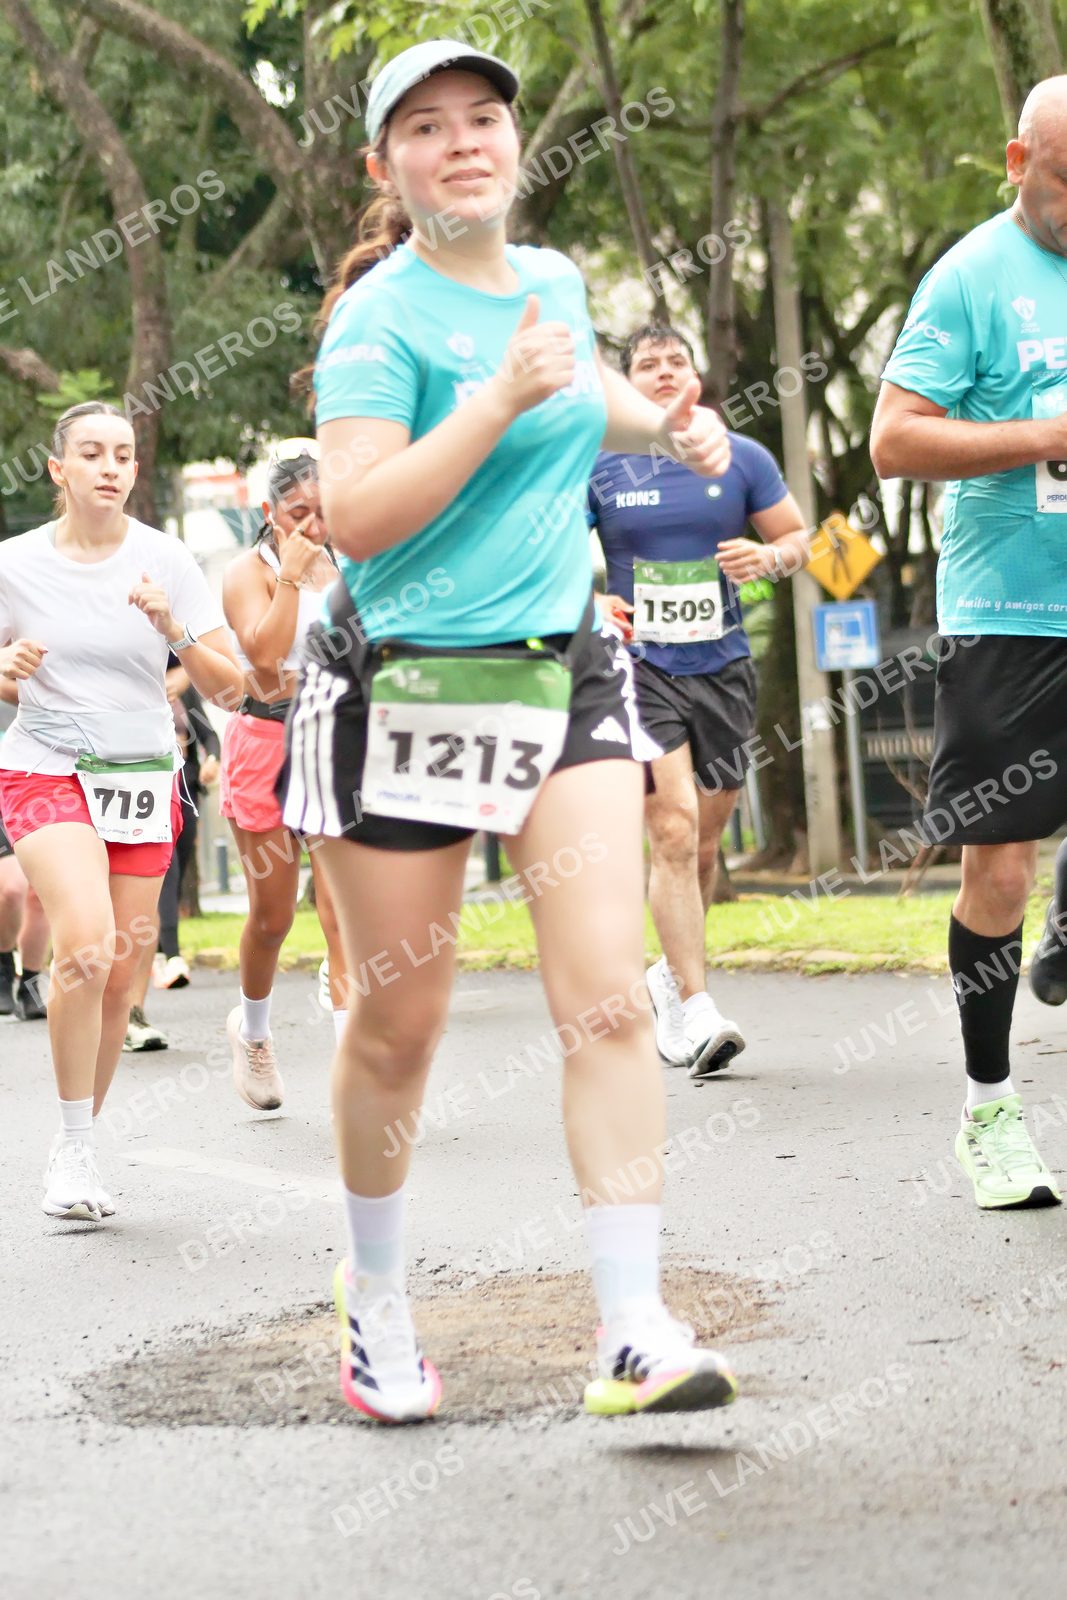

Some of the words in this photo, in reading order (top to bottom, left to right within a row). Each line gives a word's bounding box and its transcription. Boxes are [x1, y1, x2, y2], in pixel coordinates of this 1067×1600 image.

[1016, 337, 1067, 373] PE
[616, 489, 660, 508] KON3
[643, 598, 715, 624] 1509
[995, 600, 1001, 611] y
[1005, 602, 1044, 613] amigos
[388, 730, 544, 791] 1213
[93, 787, 155, 820] 719
